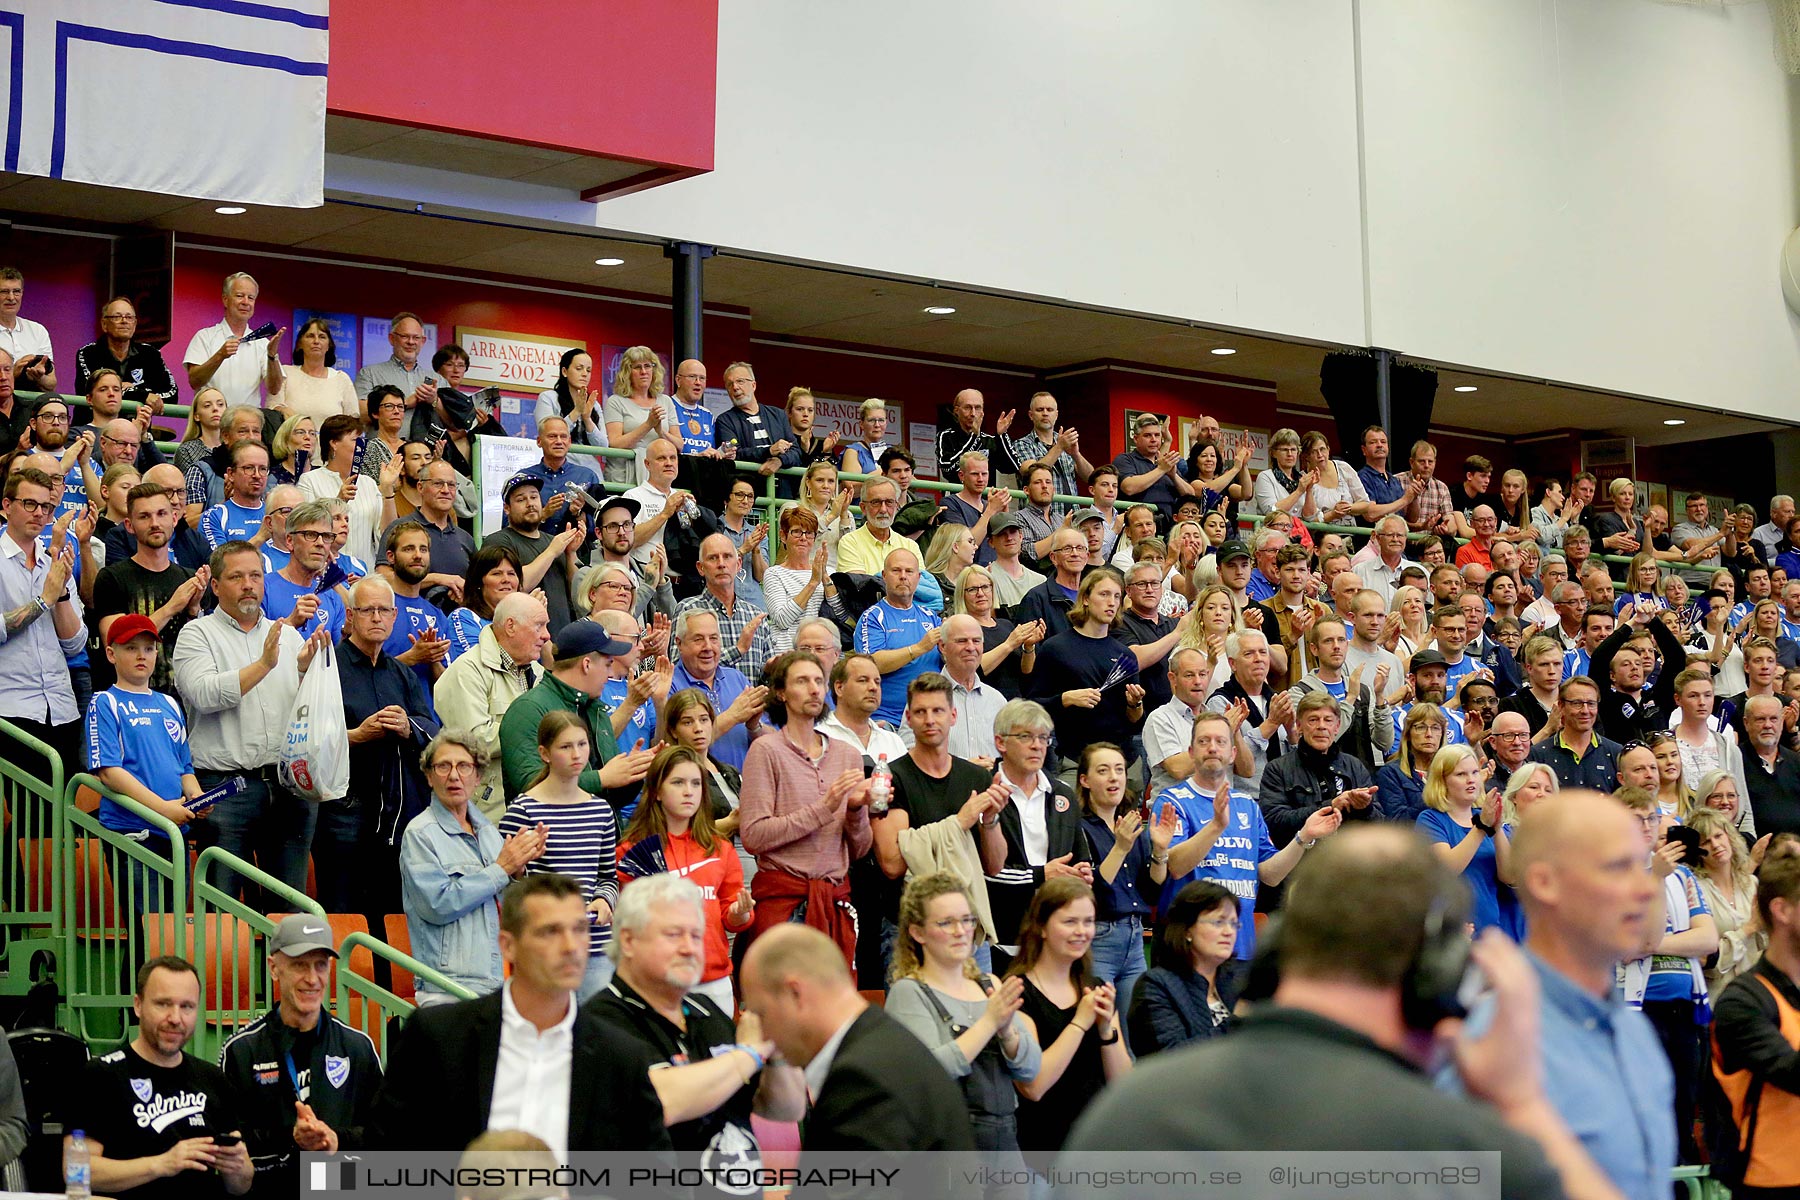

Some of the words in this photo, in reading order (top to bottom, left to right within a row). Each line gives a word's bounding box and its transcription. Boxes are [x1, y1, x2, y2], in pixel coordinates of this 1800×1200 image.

[499, 362, 545, 383] 2002
[815, 401, 897, 424] RRANGENG
[831, 420, 862, 438] 200
[119, 701, 138, 715] 14
[1214, 836, 1253, 850] OLVO
[132, 1090, 208, 1128] Salming
